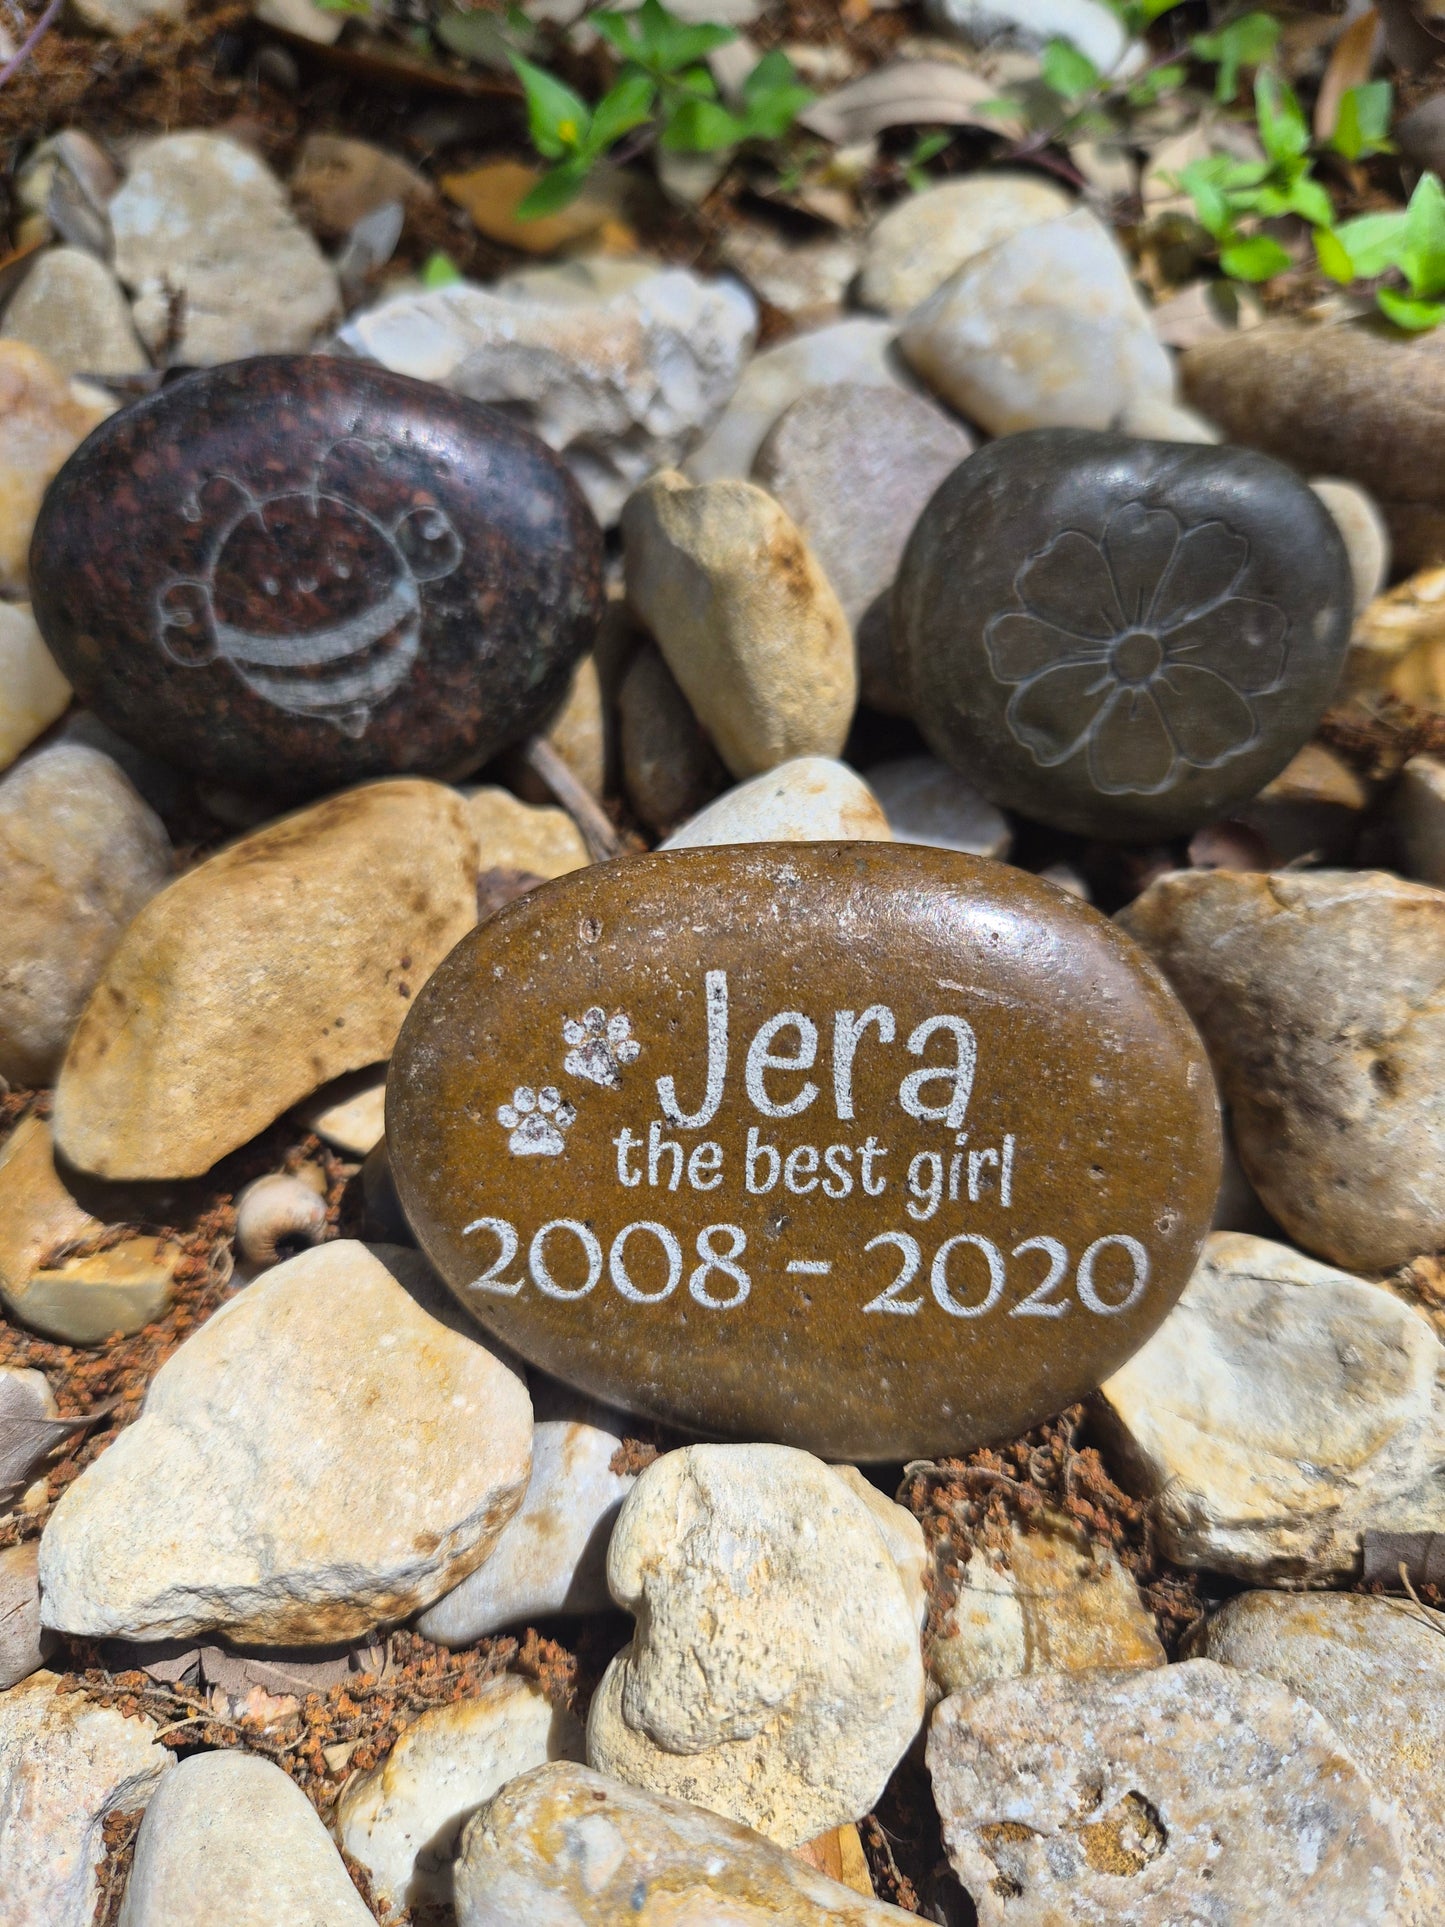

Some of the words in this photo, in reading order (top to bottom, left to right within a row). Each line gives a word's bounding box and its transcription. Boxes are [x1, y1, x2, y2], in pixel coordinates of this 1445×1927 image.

[654, 969, 978, 1130] Jera
[612, 1119, 724, 1192] the
[744, 1126, 888, 1199] best
[907, 1131, 1017, 1222] girl
[461, 1216, 752, 1310] 2008
[862, 1229, 1152, 1318] 2020
